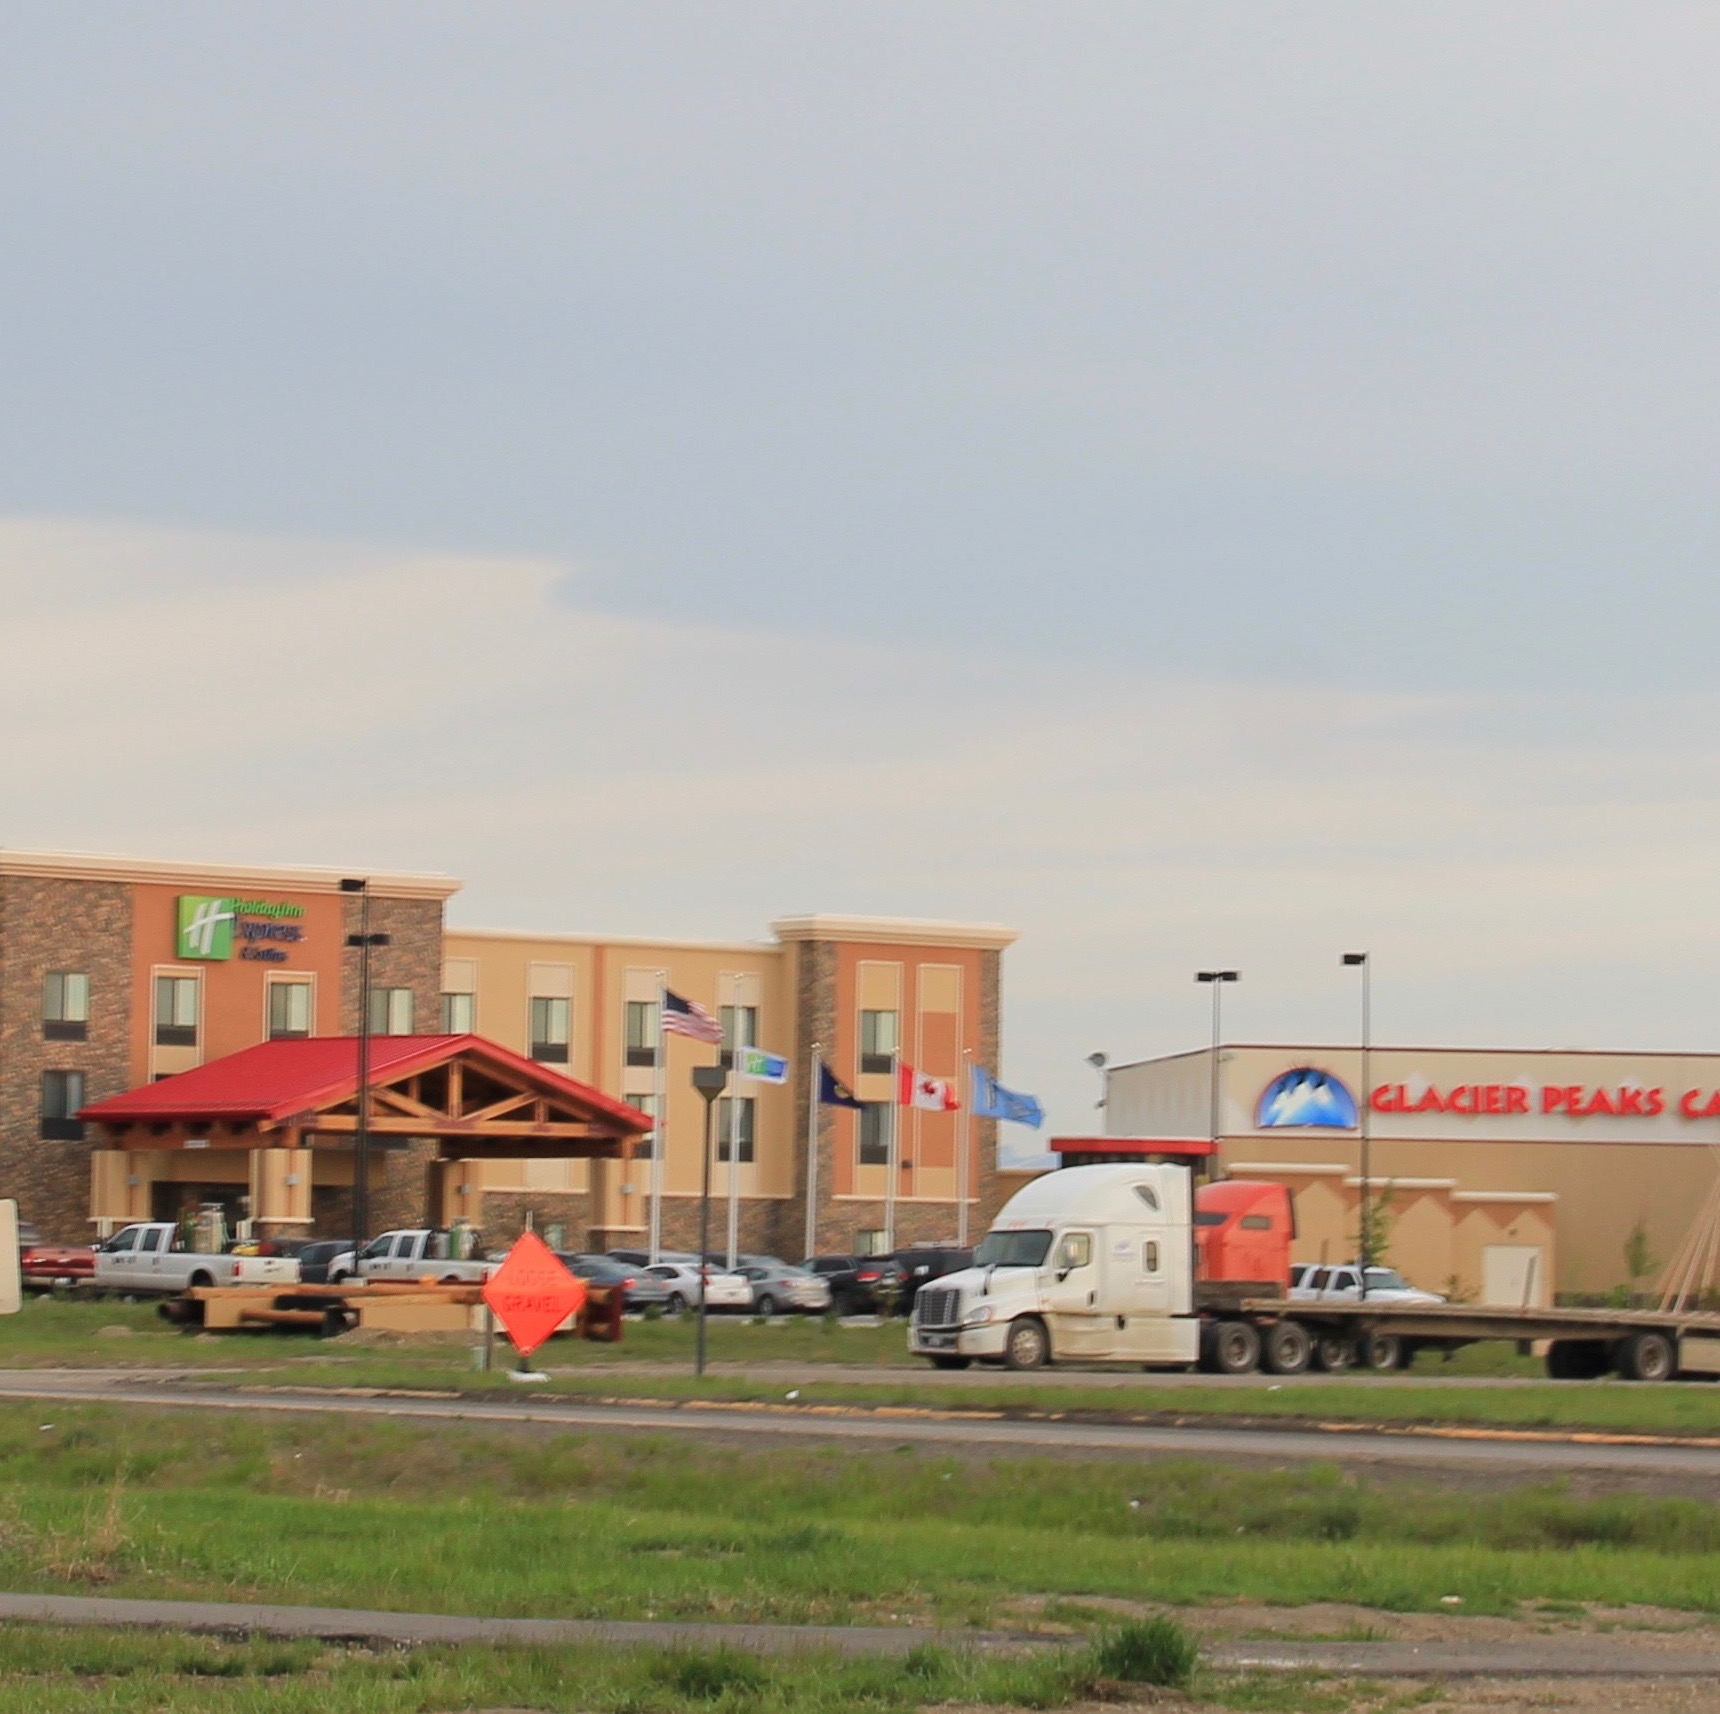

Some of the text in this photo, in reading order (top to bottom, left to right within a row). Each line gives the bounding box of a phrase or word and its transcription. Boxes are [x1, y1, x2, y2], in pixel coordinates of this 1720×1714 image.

[1370, 1083, 1530, 1114] GLACIER
[1540, 1084, 1664, 1117] PEAKS
[502, 1295, 563, 1313] GRAVEL
